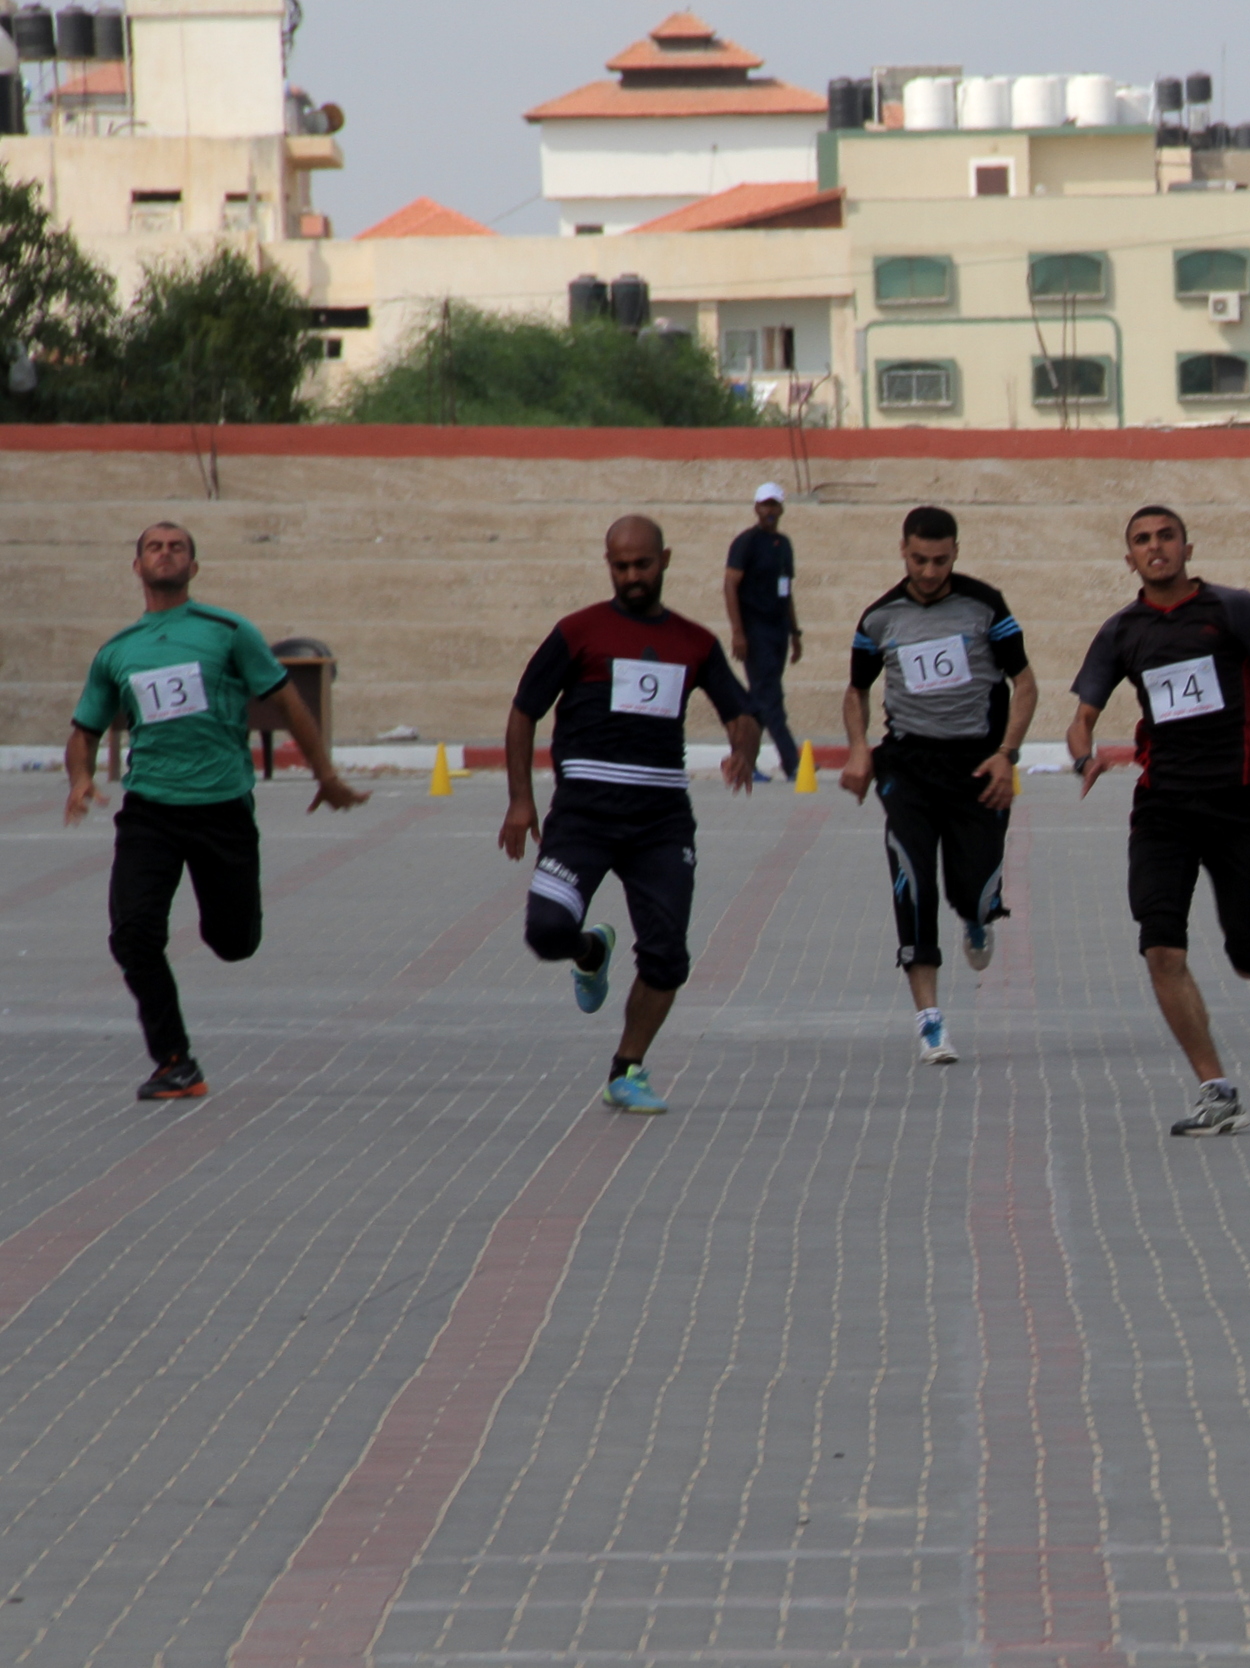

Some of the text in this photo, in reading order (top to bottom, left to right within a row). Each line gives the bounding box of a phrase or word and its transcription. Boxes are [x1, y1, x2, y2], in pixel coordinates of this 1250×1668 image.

[913, 649, 954, 681] 16
[145, 676, 188, 711] 13
[638, 673, 659, 704] 9
[1161, 673, 1204, 708] 14
